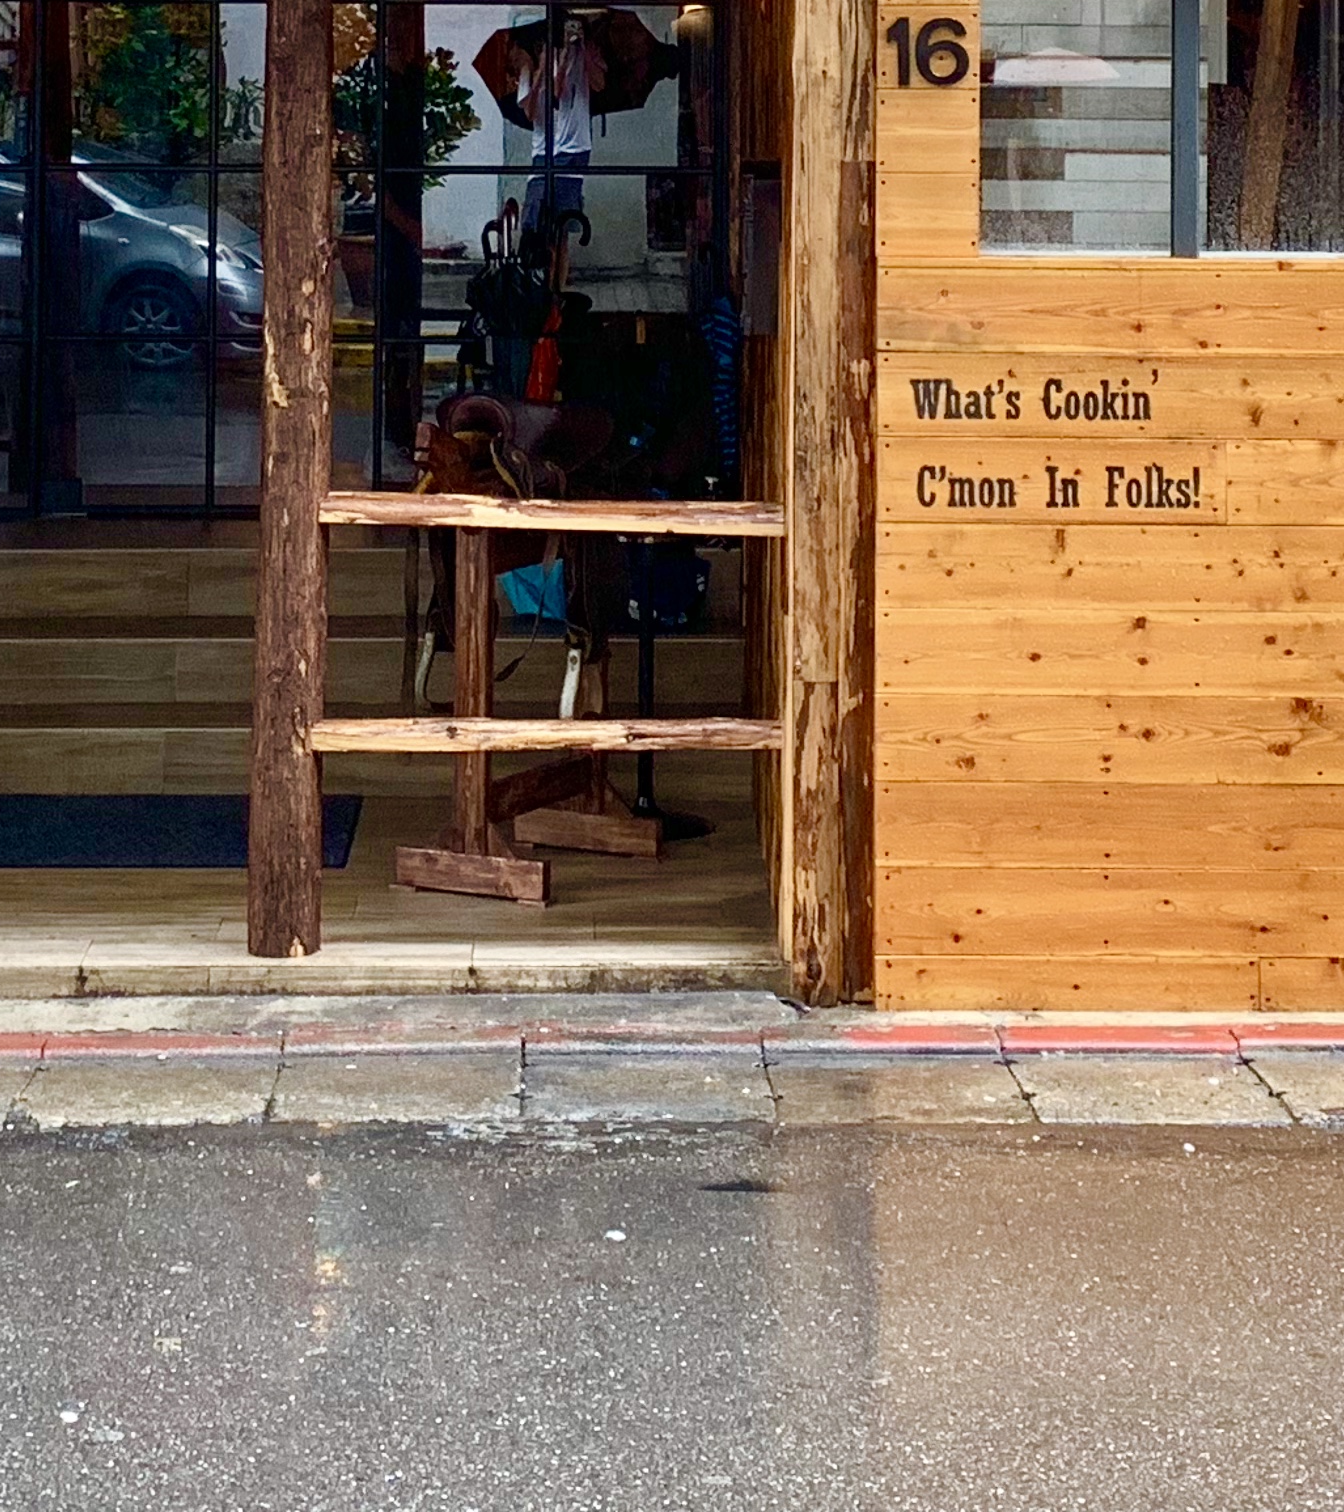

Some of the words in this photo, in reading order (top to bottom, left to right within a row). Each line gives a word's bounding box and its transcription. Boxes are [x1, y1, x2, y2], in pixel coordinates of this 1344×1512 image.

[886, 17, 970, 88] 16
[909, 378, 1021, 421] What's
[1043, 368, 1159, 421] Cookin'
[916, 465, 1017, 509] C'mon
[1045, 465, 1080, 509] In
[1104, 462, 1202, 509] Folks!
